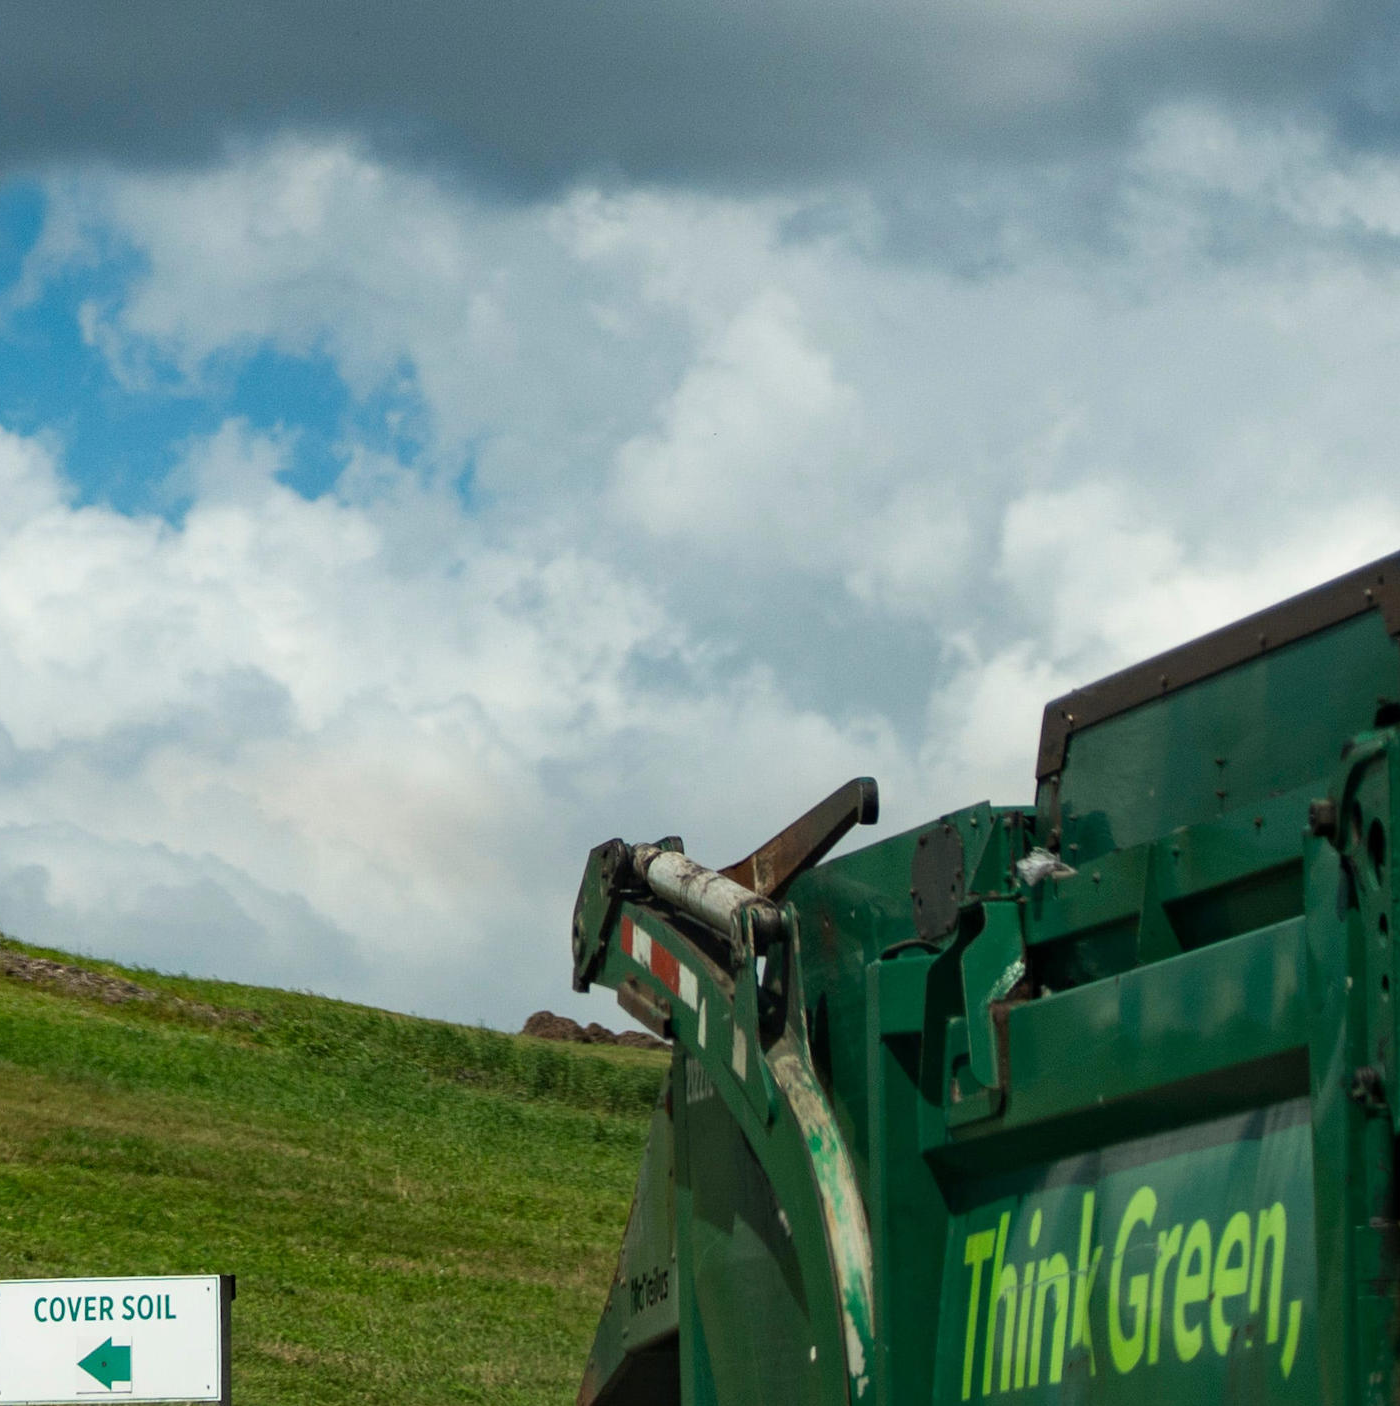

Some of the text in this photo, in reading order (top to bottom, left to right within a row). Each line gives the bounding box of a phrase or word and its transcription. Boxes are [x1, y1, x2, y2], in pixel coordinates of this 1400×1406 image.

[33, 1293, 177, 1322] COVER SOIL
[961, 1185, 1302, 1401] Think Green,
